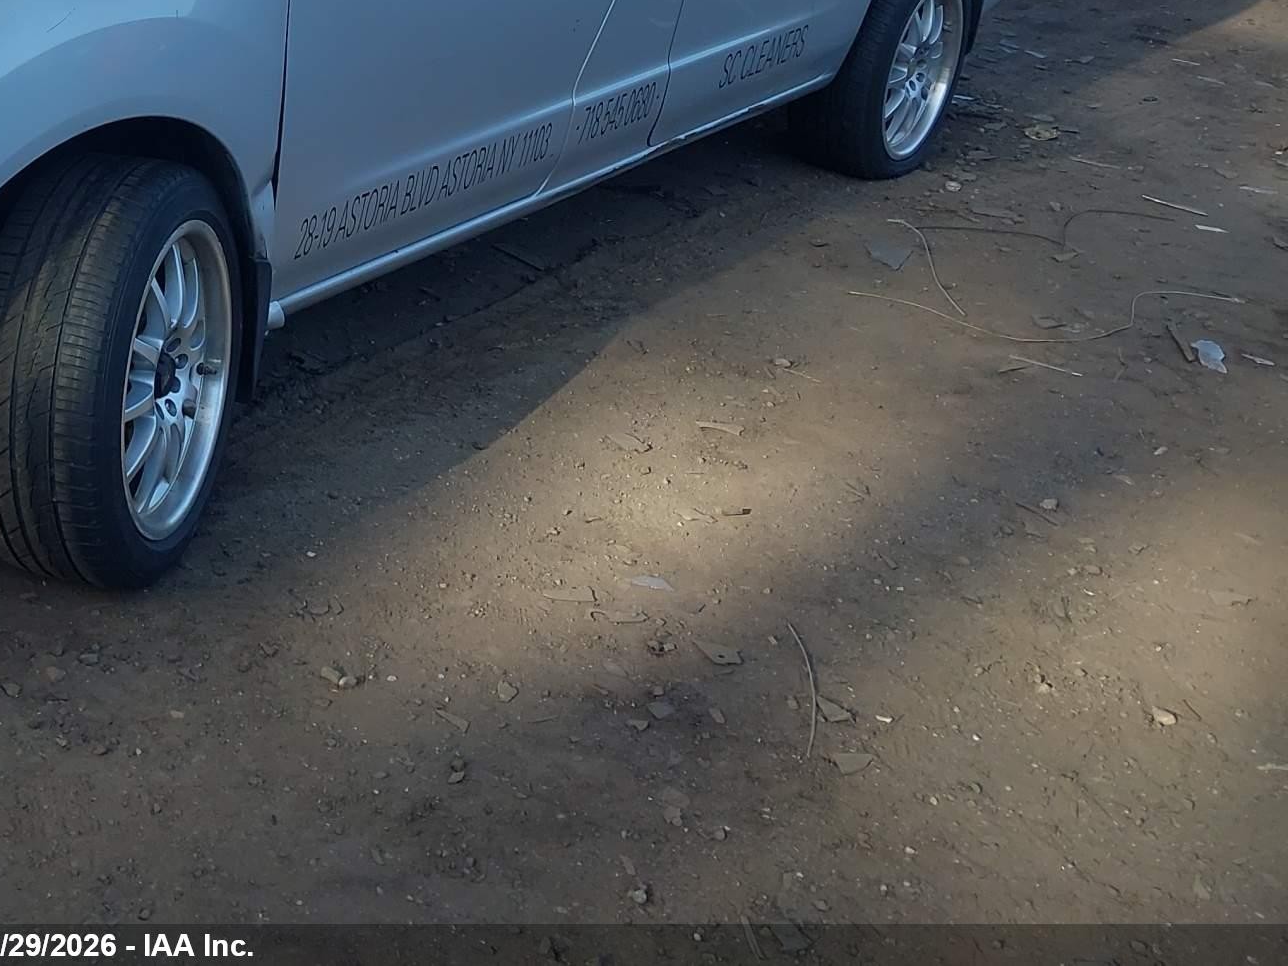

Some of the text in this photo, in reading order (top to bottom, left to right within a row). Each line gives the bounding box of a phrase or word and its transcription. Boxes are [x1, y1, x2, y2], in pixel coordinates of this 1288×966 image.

[718, 24, 809, 89] SC CLEANERS
[293, 206, 337, 260] 28-19
[334, 180, 400, 242] ASTORIA
[400, 165, 440, 215] BLVD
[437, 142, 498, 201] ASTORIA
[496, 133, 521, 176] NY
